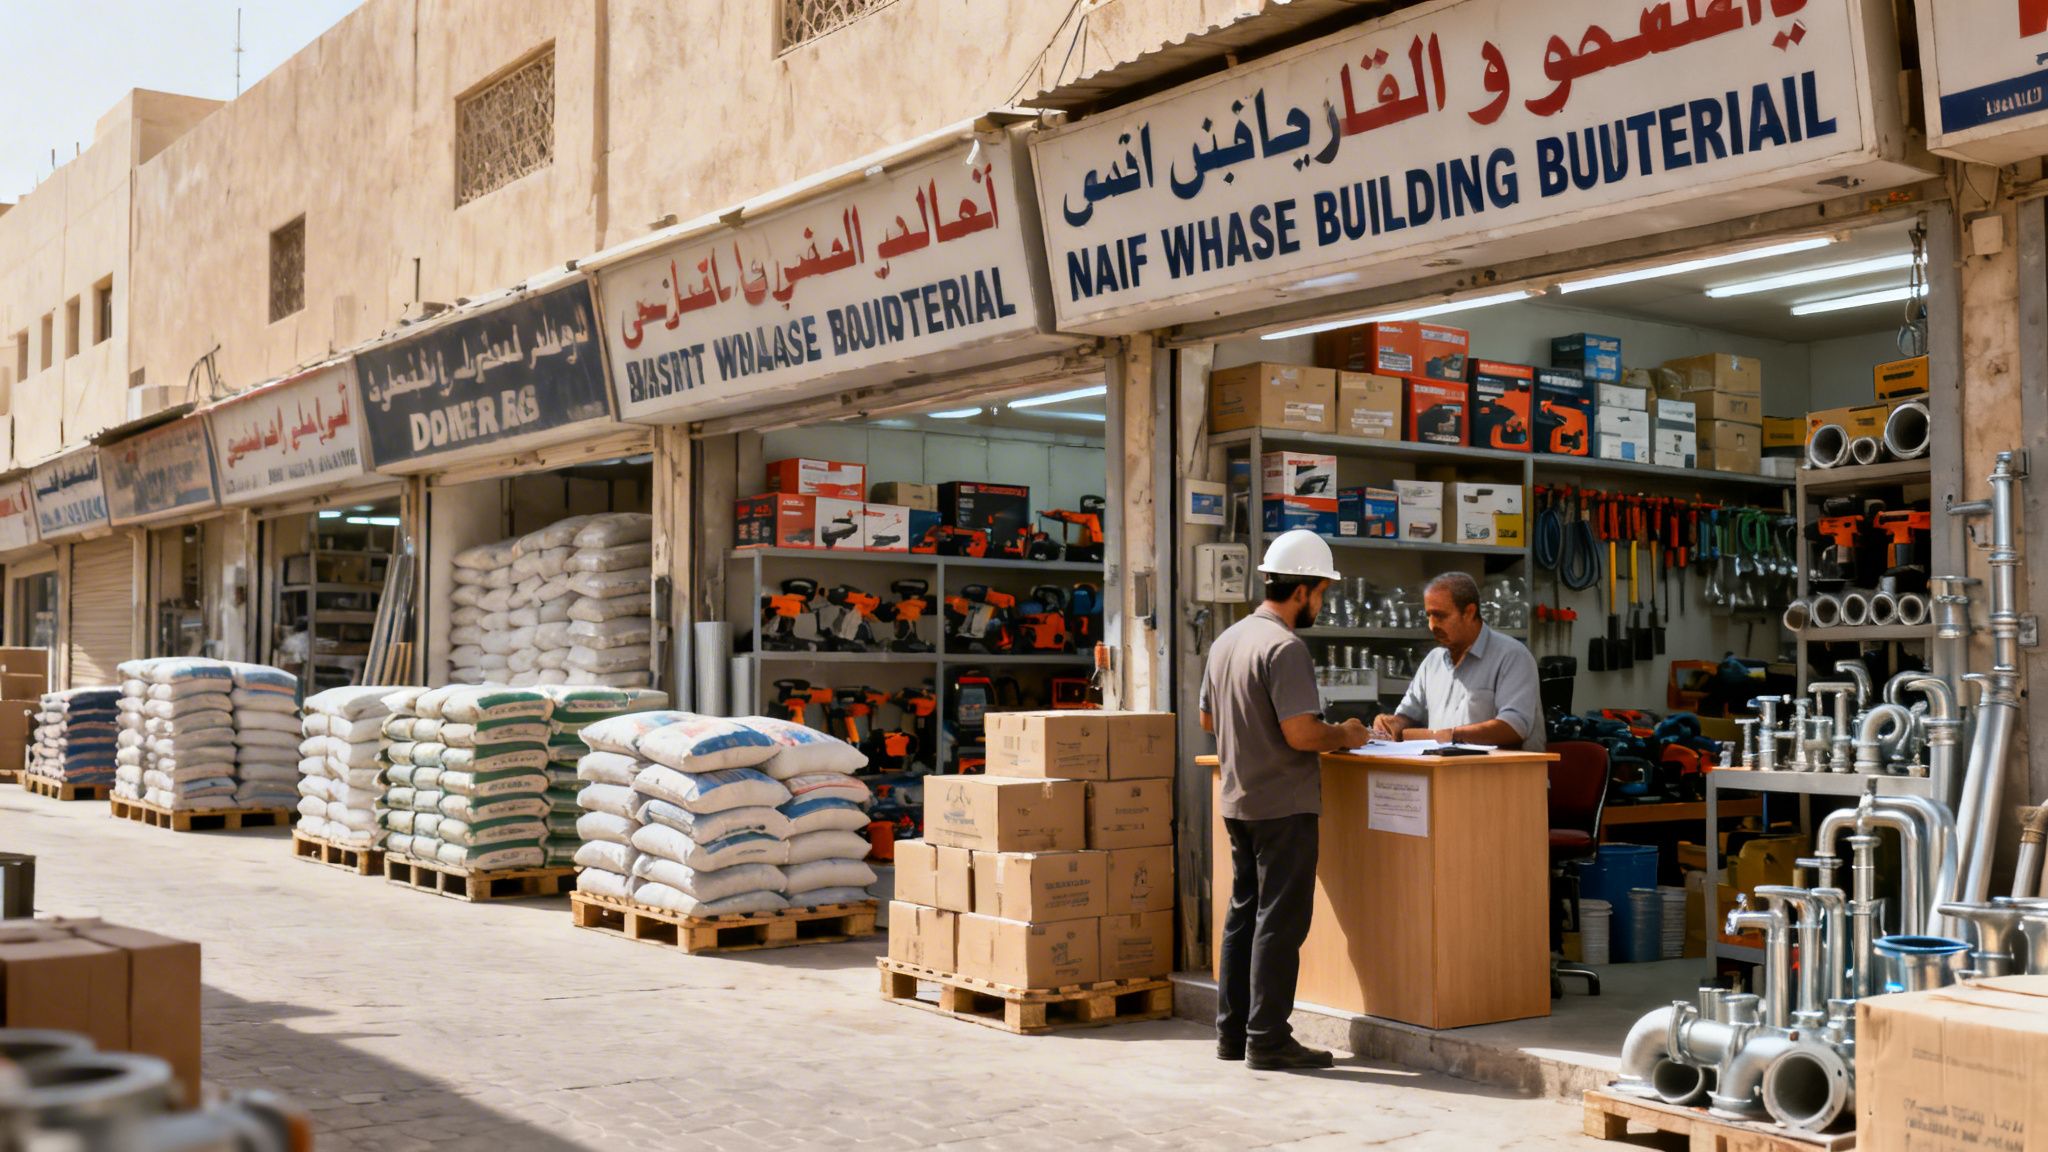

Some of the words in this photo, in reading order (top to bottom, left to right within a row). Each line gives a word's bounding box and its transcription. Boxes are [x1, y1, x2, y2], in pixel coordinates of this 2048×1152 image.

[1067, 232, 1148, 302] NAIF
[1161, 198, 1301, 280] WHASE
[1314, 147, 1520, 247] BUILDING
